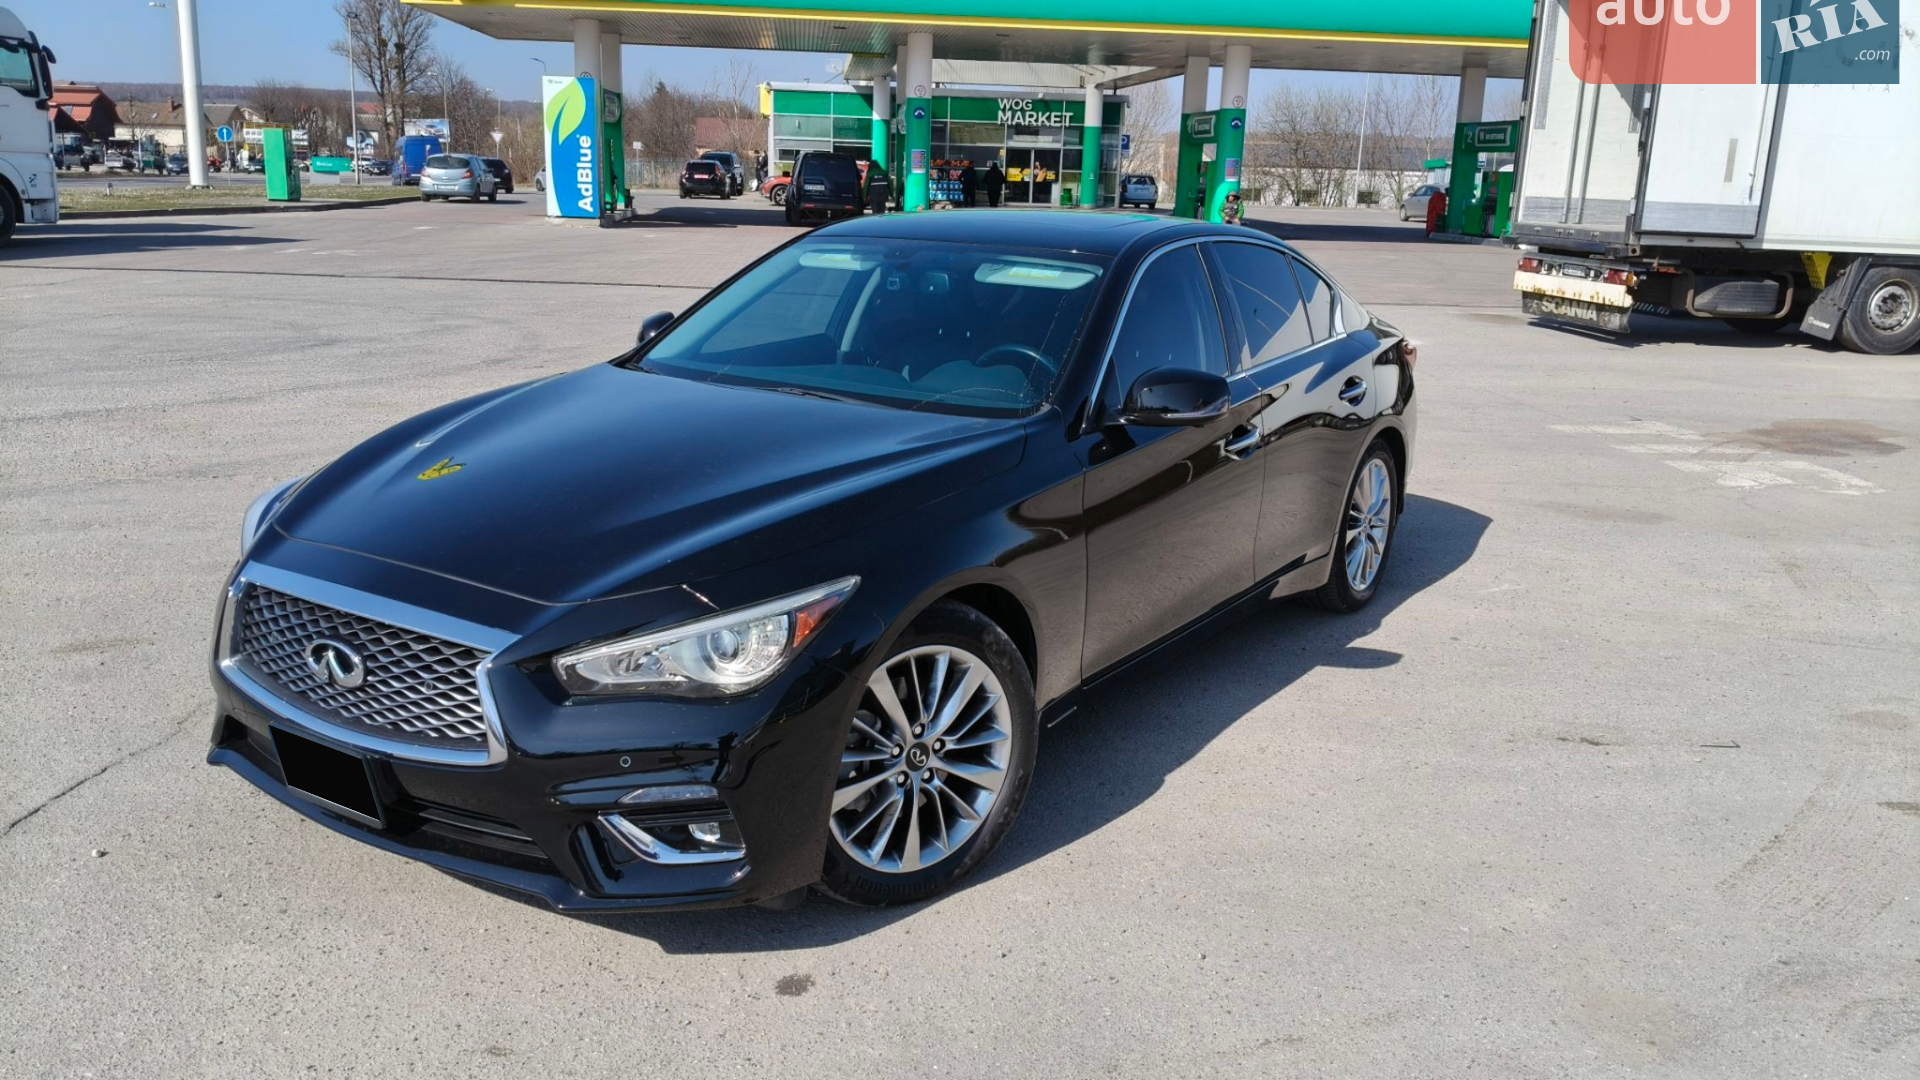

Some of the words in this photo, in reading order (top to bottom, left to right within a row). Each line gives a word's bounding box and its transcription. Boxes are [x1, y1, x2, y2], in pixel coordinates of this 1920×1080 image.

[997, 98, 1033, 111] WOG
[997, 110, 1074, 127] MARKET
[577, 135, 594, 213] AdBlue
[1541, 296, 1598, 321] SCANIA
